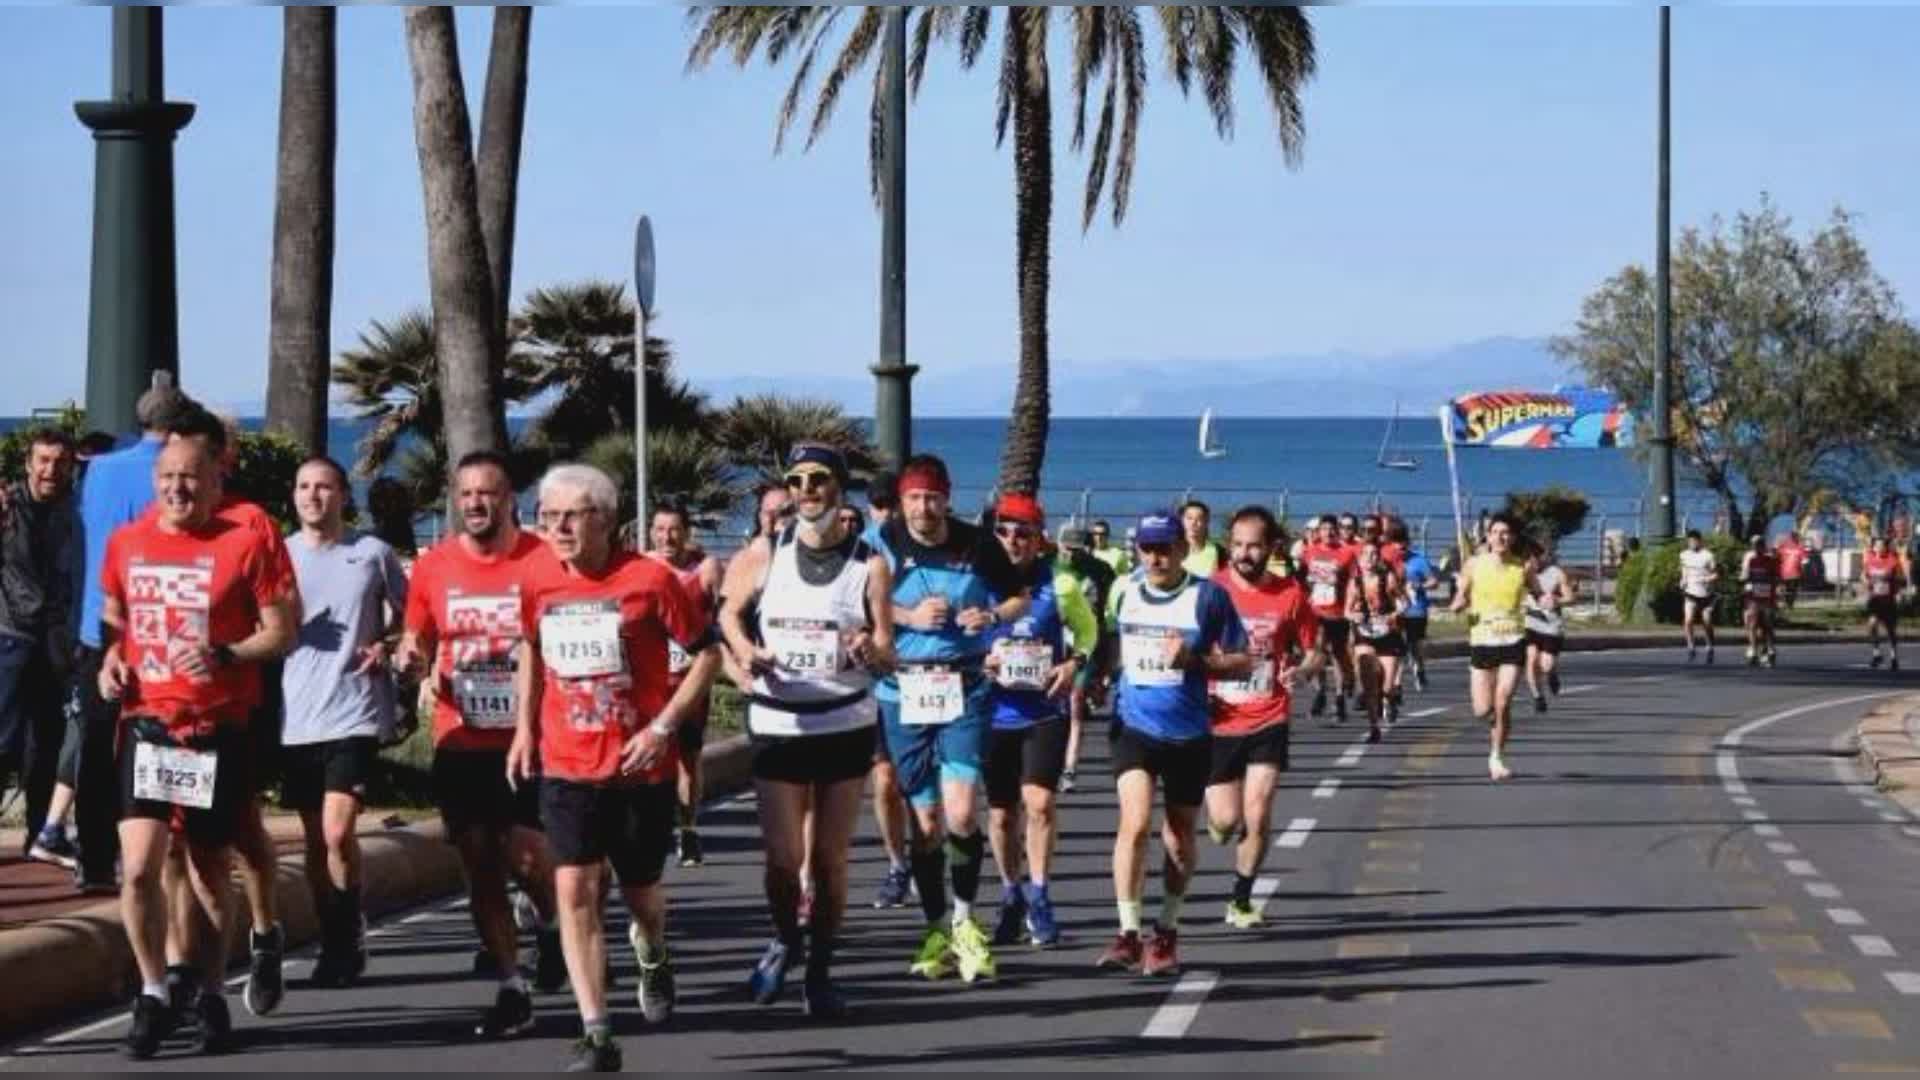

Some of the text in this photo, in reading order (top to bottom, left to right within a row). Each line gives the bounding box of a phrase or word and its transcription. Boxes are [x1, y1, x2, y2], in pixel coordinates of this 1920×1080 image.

[1466, 401, 1575, 443] SUPERMAN
[558, 641, 603, 659] 1215
[470, 696, 509, 712] 1141
